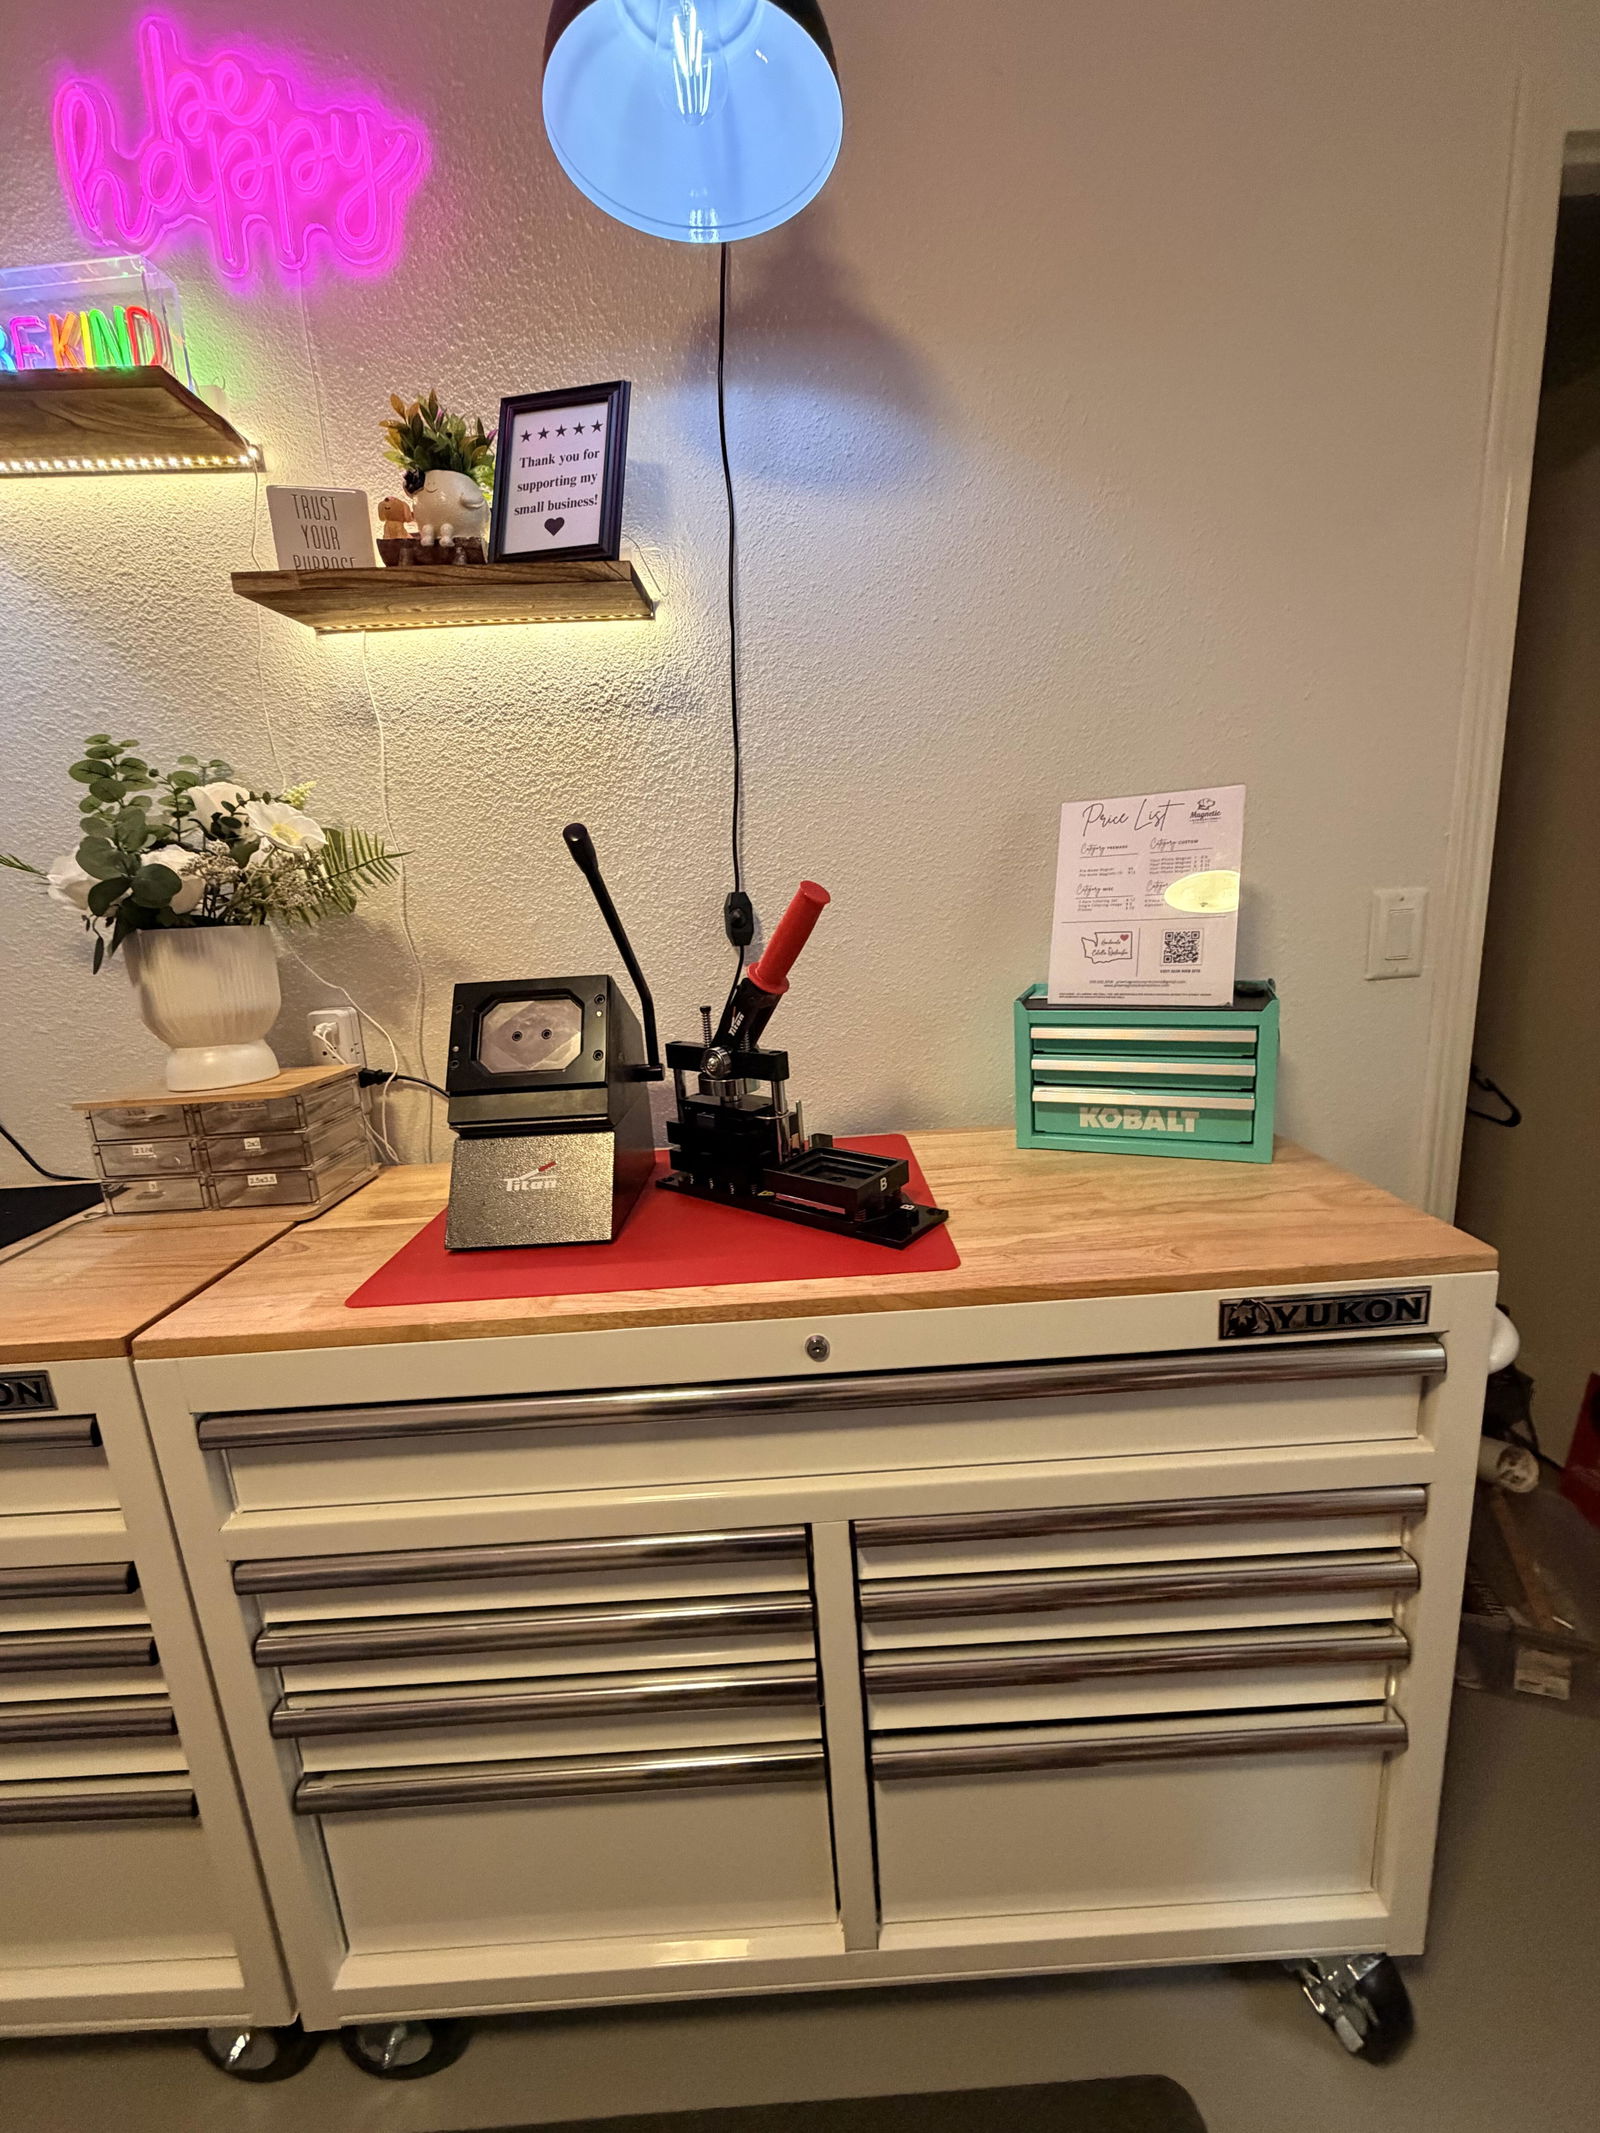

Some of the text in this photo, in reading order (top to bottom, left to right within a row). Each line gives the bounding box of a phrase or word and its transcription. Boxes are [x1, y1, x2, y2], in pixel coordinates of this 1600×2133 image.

[147, 24, 278, 142] be
[61, 90, 407, 266] happy
[48, 306, 162, 371] KIND
[519, 449, 600, 468] Thank you for
[517, 473, 598, 493] supporting my
[291, 494, 338, 520] TRUST
[514, 494, 598, 516] small business!
[301, 525, 340, 550] YOUR
[1082, 798, 1185, 837] Price List
[1189, 810, 1222, 821] Magnetic
[1079, 1106, 1200, 1132] KOBALT
[501, 1170, 558, 1191] Titan
[880, 1177, 888, 1191] B
[1273, 1296, 1426, 1329] YUKON
